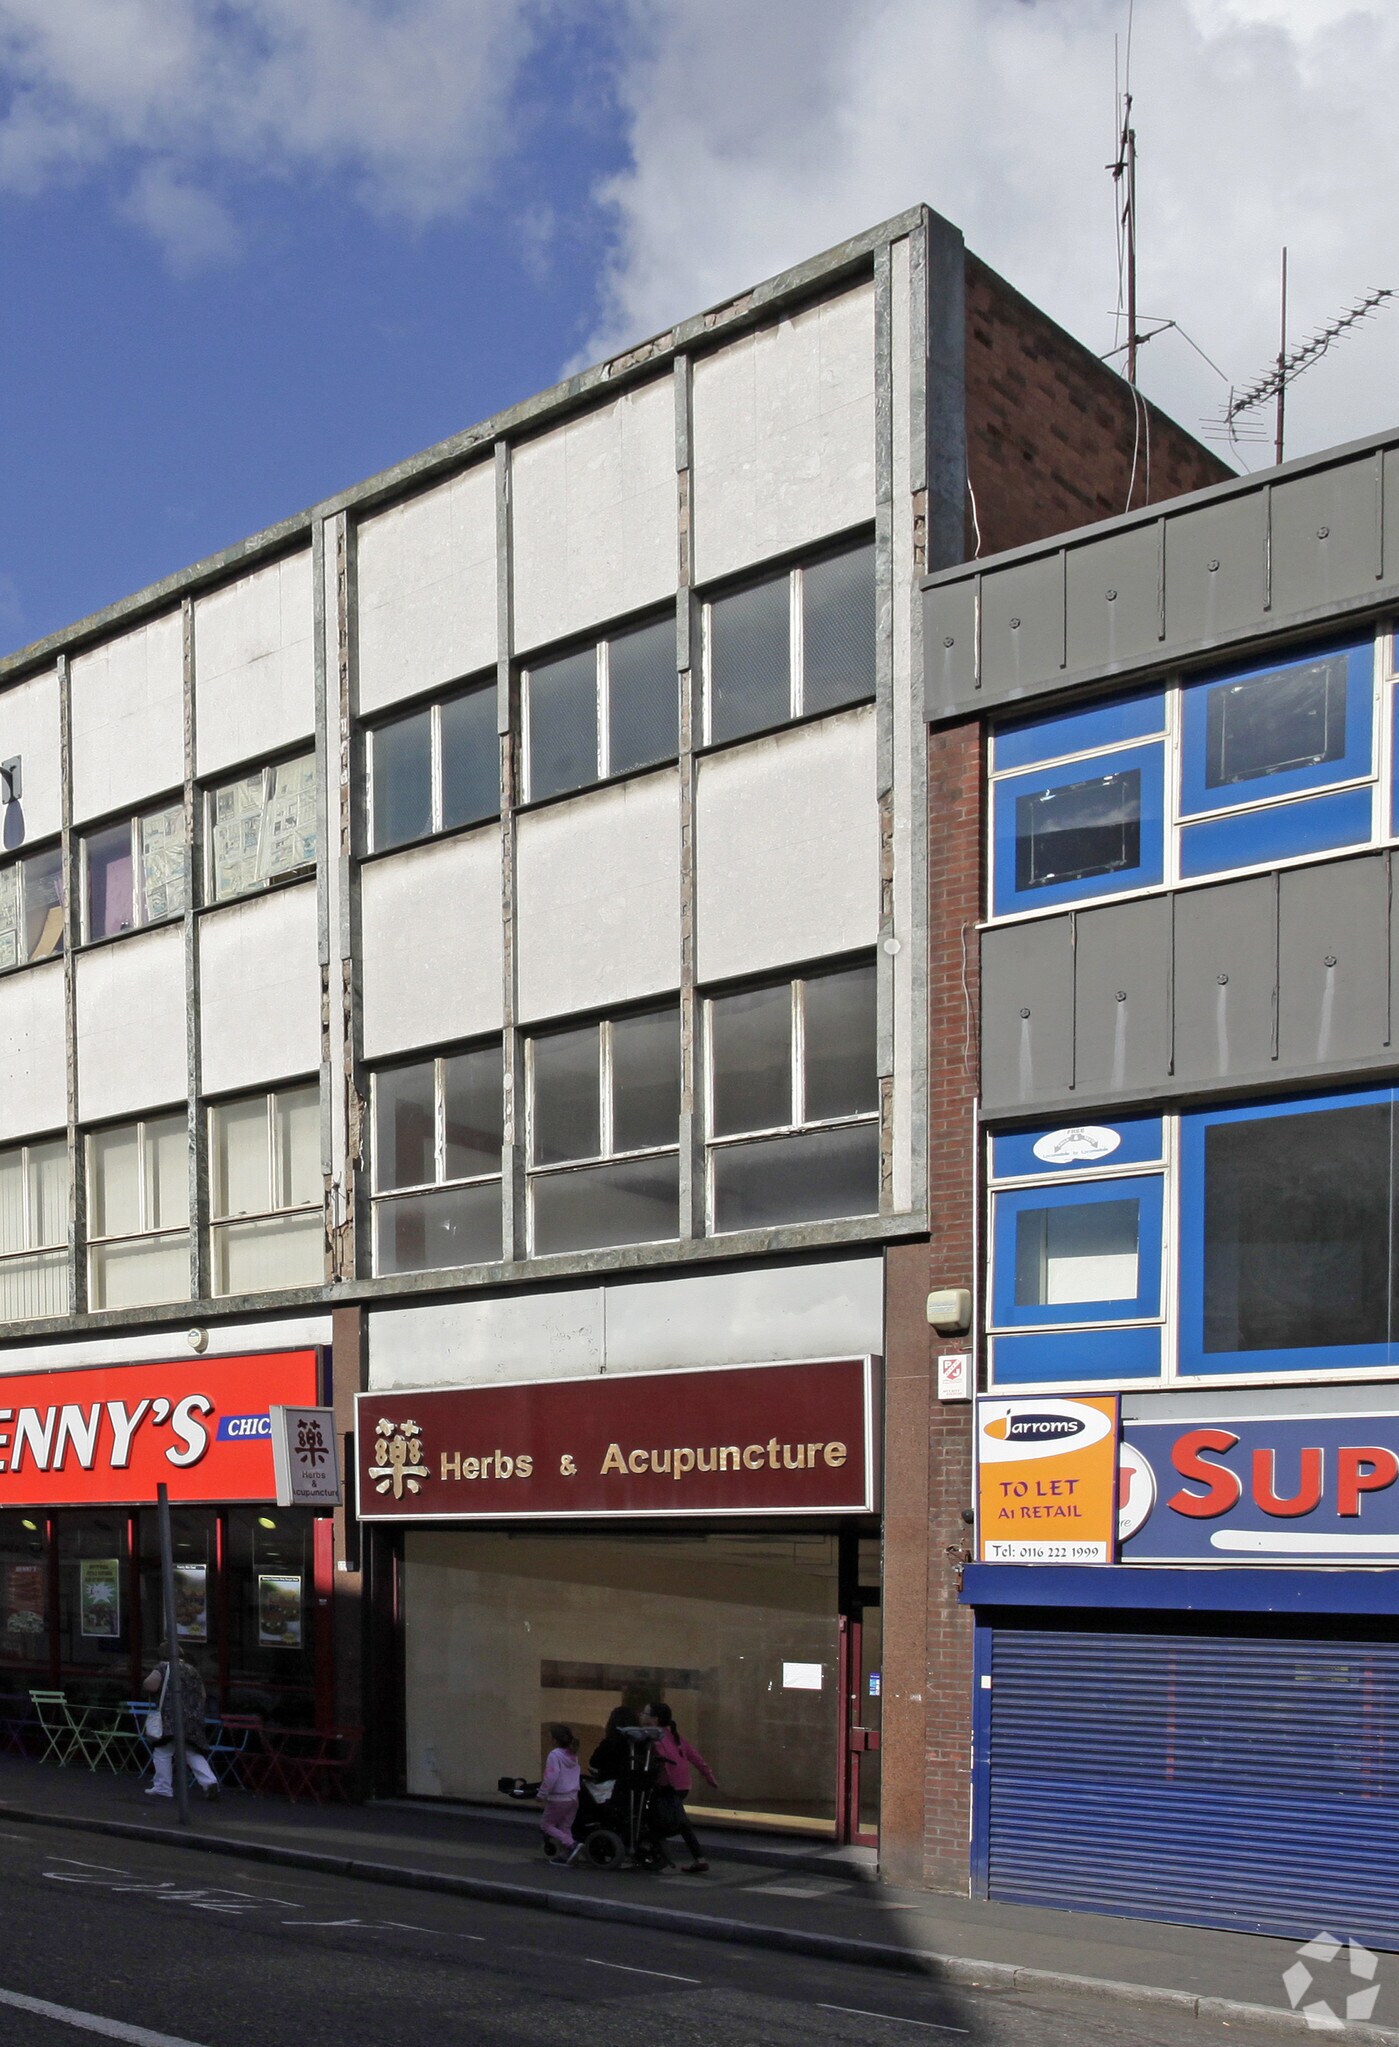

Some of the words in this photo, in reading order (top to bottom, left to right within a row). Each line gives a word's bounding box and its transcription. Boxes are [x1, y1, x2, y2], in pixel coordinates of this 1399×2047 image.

[228, 1418, 272, 1436] CHIC
[1003, 1408, 1078, 1440] jarroms
[441, 1450, 533, 1480] Herbs
[560, 1454, 577, 1476] &
[600, 1437, 847, 1480] Acupuncture
[302, 1471, 326, 1479] Herbs
[1167, 1429, 1399, 1519] SUP
[311, 1480, 317, 1488] &
[999, 1481, 1028, 1498] TO
[1036, 1479, 1080, 1496] LET
[998, 1507, 1015, 1519] A1
[1021, 1505, 1082, 1519] RETAIL
[992, 1544, 1016, 1558] Tel:
[1020, 1547, 1044, 1558] 0116
[1048, 1547, 1067, 1558] 222
[1072, 1546, 1099, 1558] 1999
